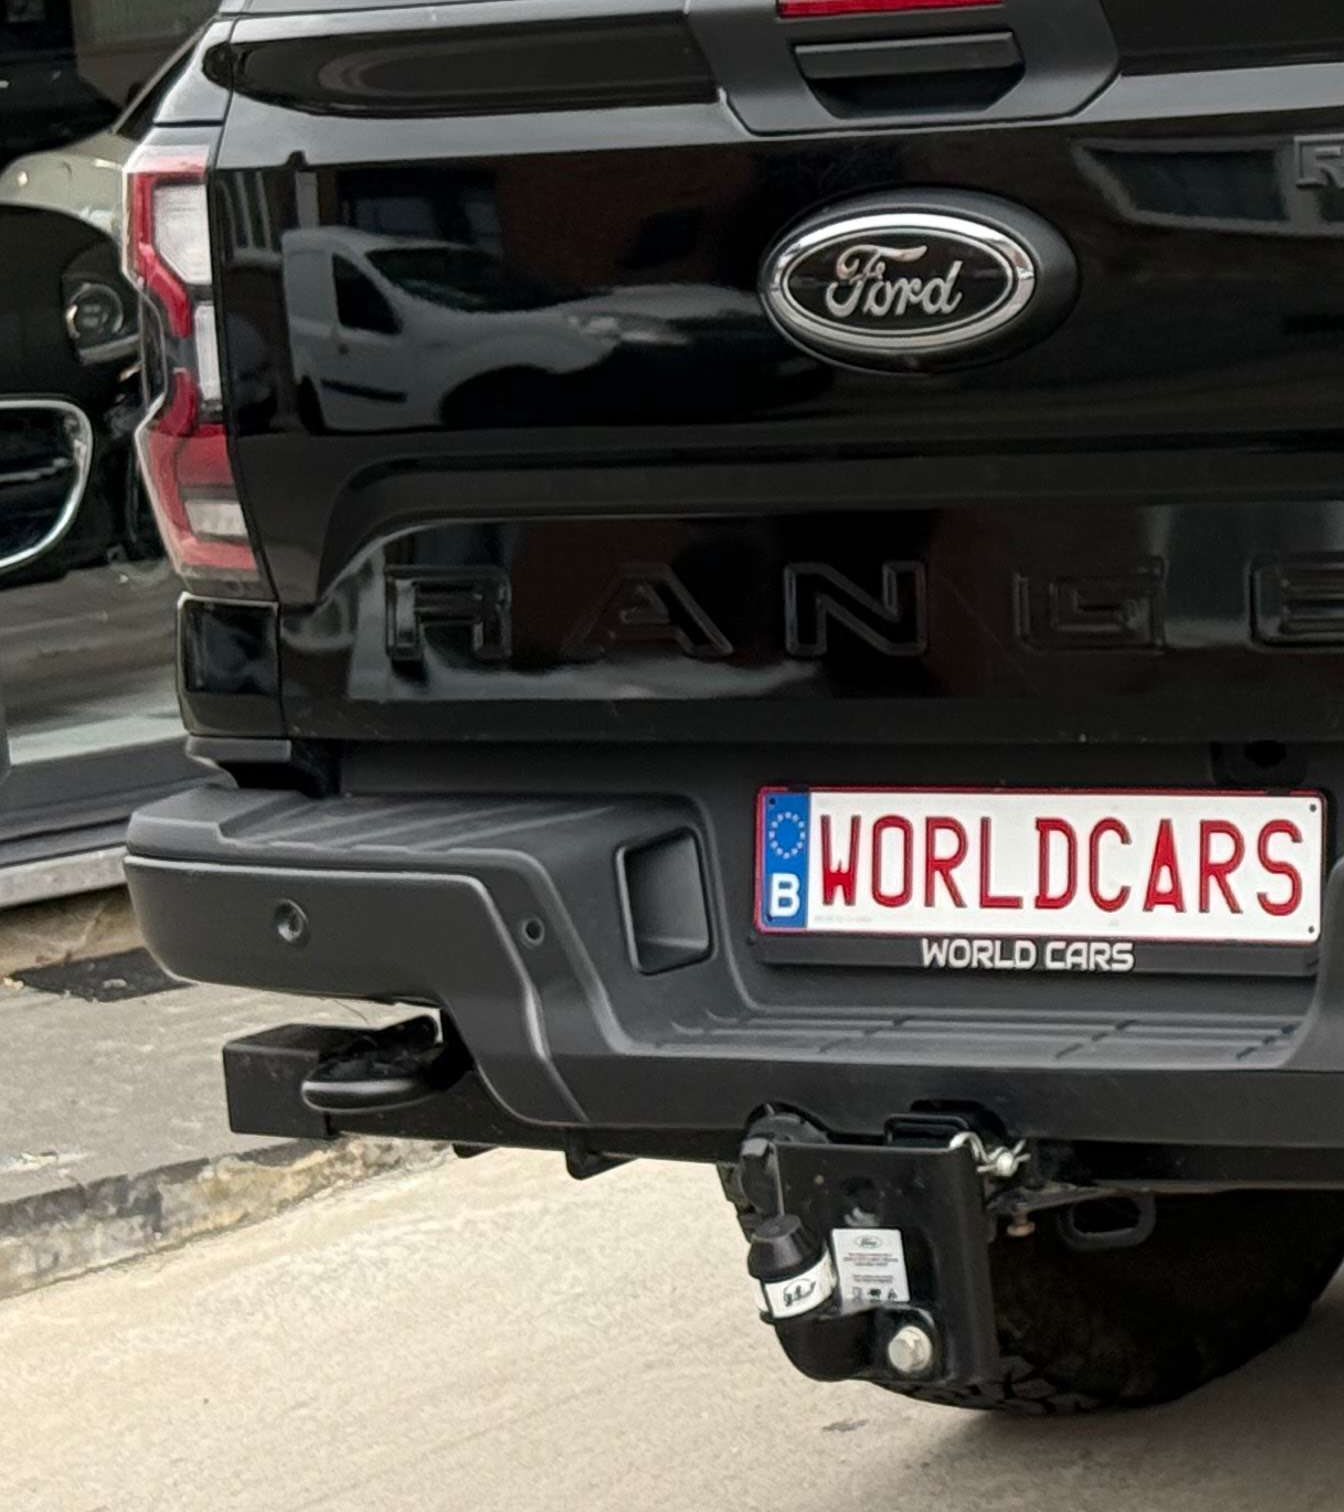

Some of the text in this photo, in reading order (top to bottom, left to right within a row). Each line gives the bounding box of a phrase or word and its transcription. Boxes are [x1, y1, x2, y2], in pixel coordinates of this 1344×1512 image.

[825, 243, 963, 317] Ford
[769, 872, 801, 918] B
[820, 813, 1304, 917] WORLDCARS
[920, 937, 1135, 972] WORLD CARS
